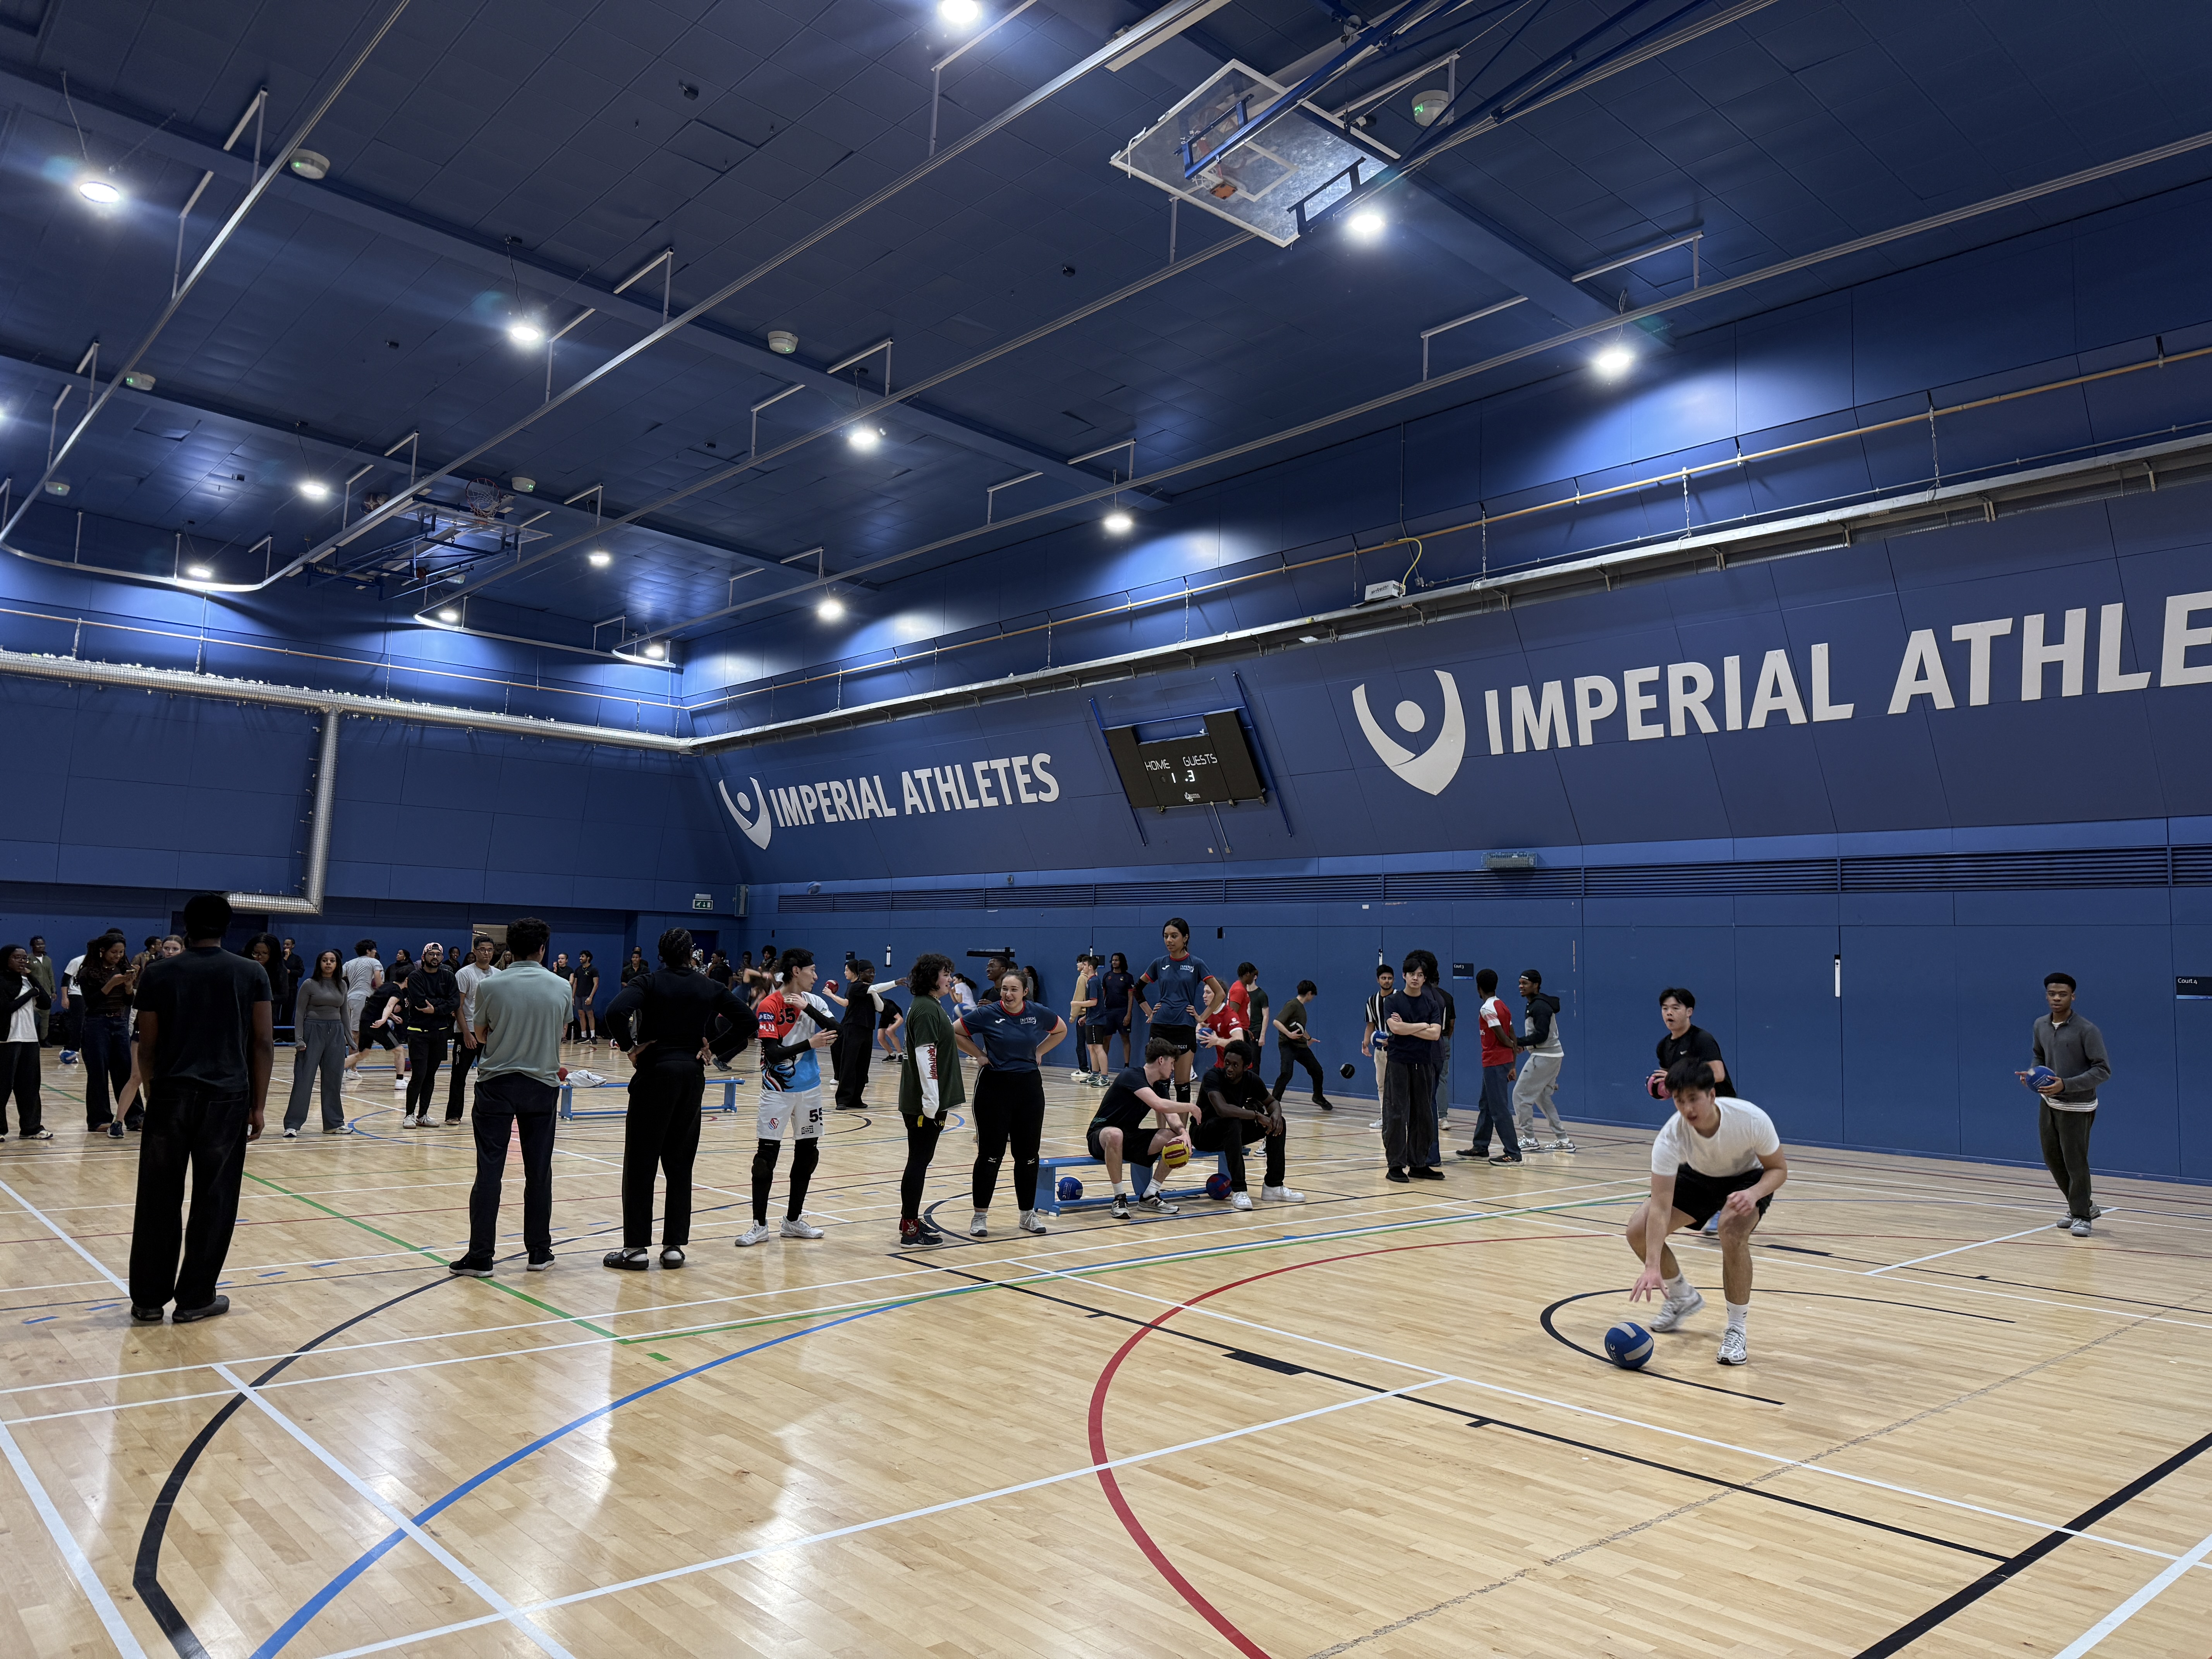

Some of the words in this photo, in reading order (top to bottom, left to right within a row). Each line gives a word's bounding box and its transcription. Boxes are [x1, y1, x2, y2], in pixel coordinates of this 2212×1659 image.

[1485, 642, 1855, 755] IMPERIAL
[1887, 591, 2212, 714] ATHLE
[769, 775, 897, 827] IMPERIAL
[902, 753, 1060, 815] ATHLETES
[1144, 759, 1171, 771] HOME
[1182, 753, 1218, 767] GUESTS
